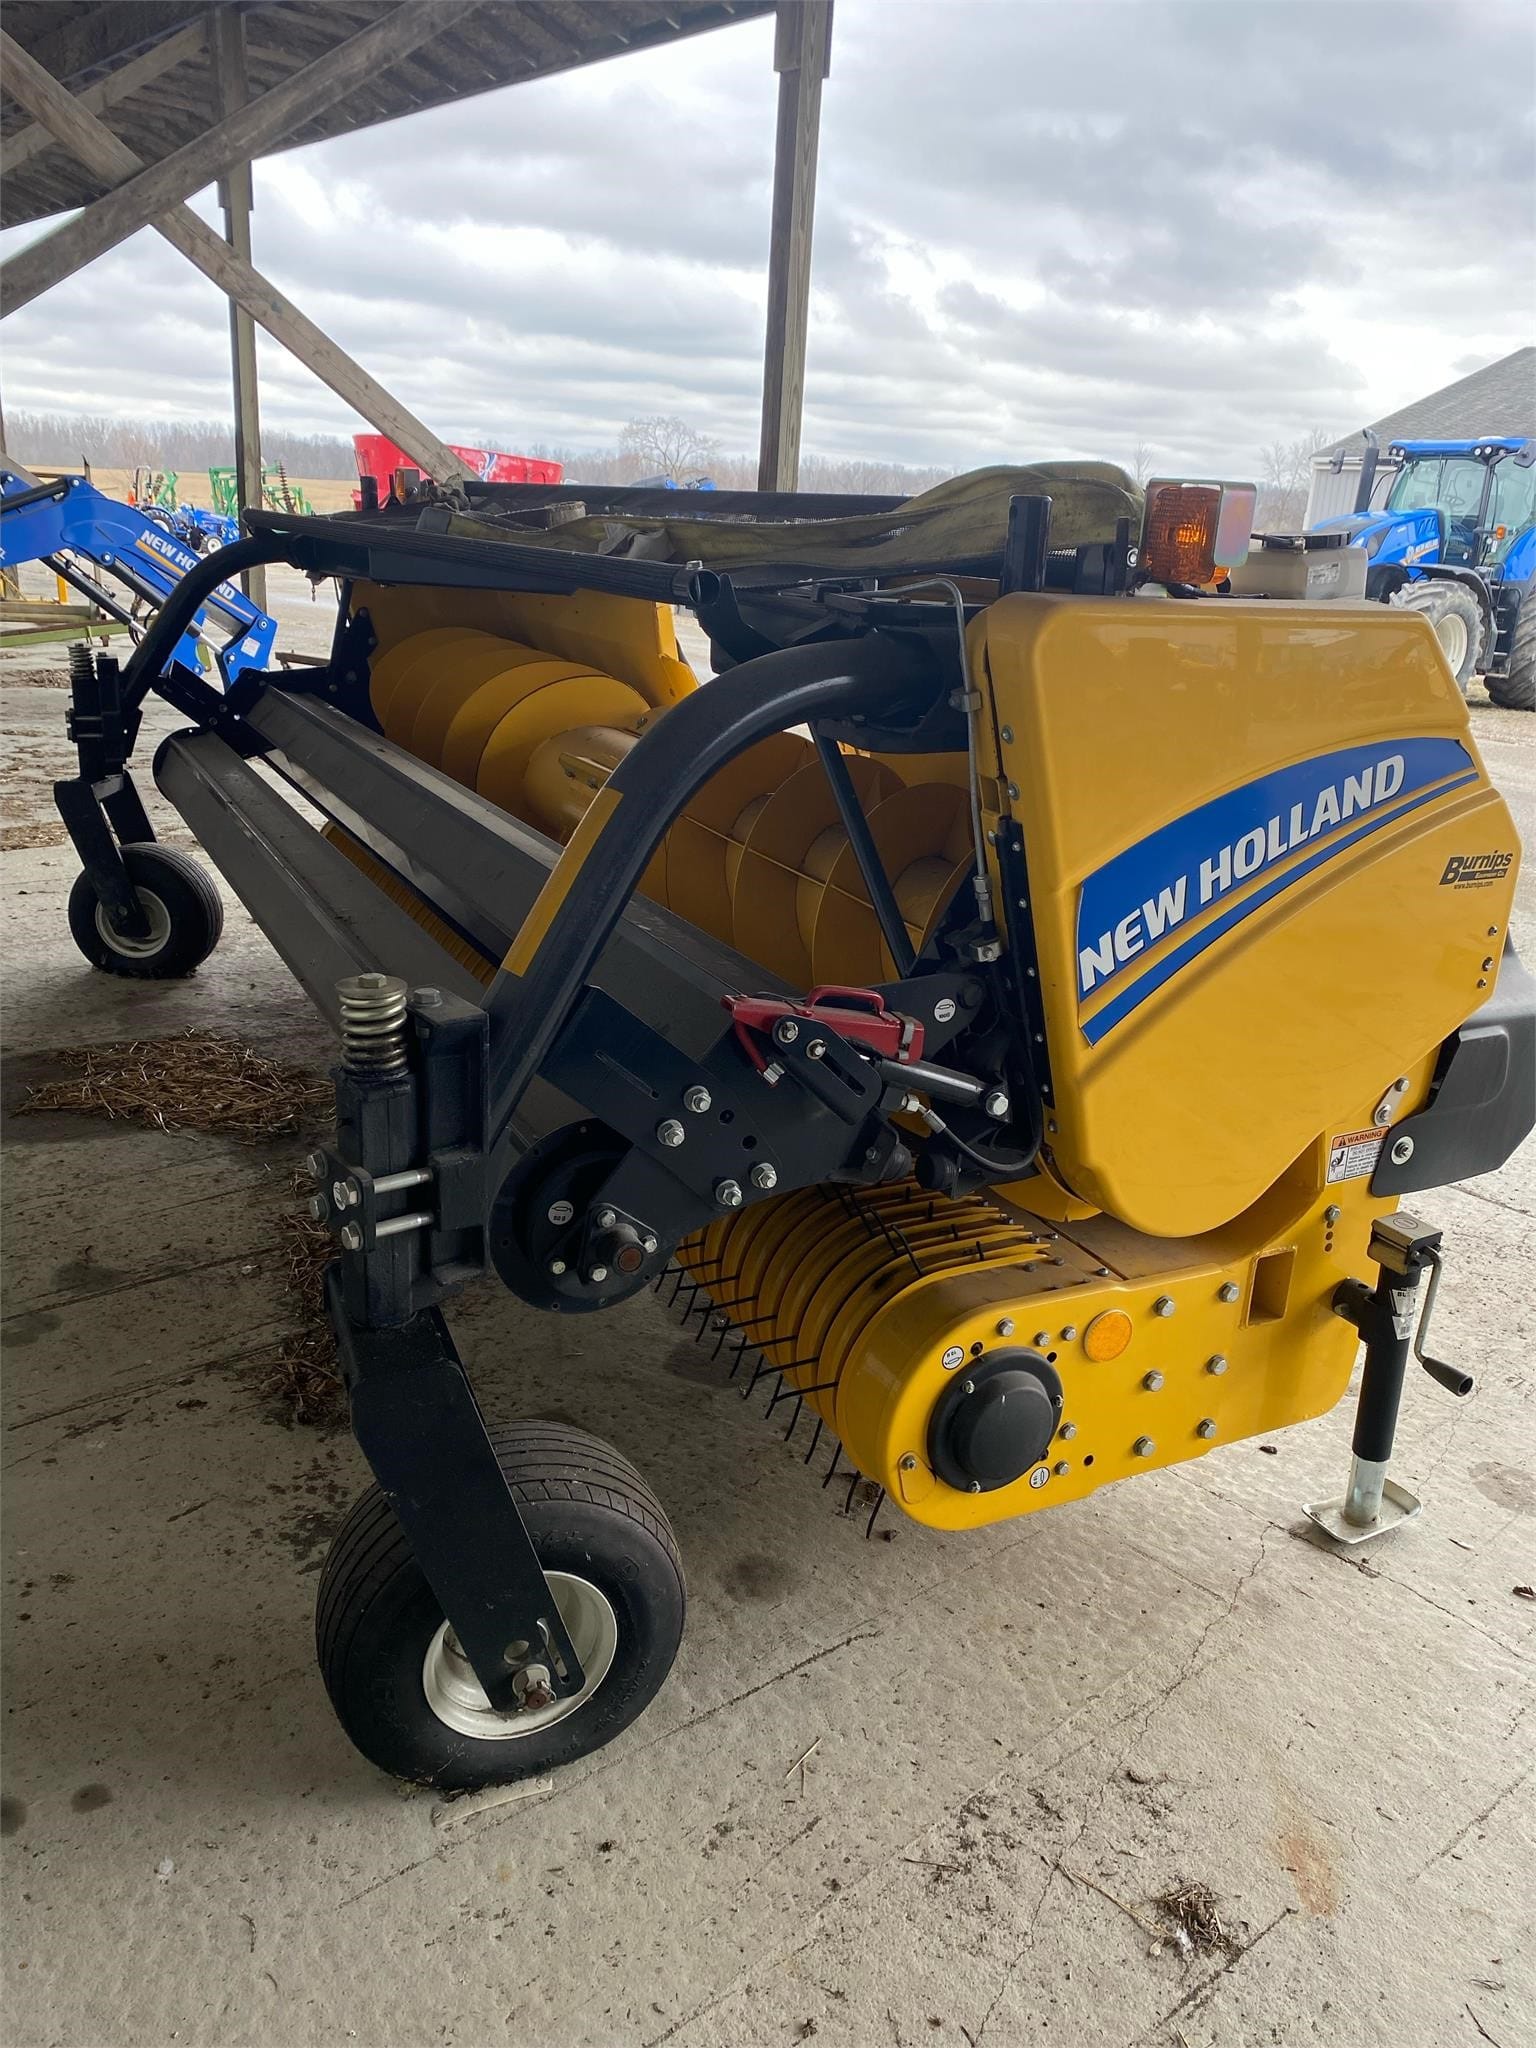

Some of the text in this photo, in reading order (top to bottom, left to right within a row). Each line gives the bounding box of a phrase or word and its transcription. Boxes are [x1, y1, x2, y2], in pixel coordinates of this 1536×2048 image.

[141, 530, 177, 558] NEW
[1079, 754, 1405, 992] NEW HOLLAND
[1439, 850, 1513, 885] Burnips
[1347, 1130, 1382, 1144] WARNING
